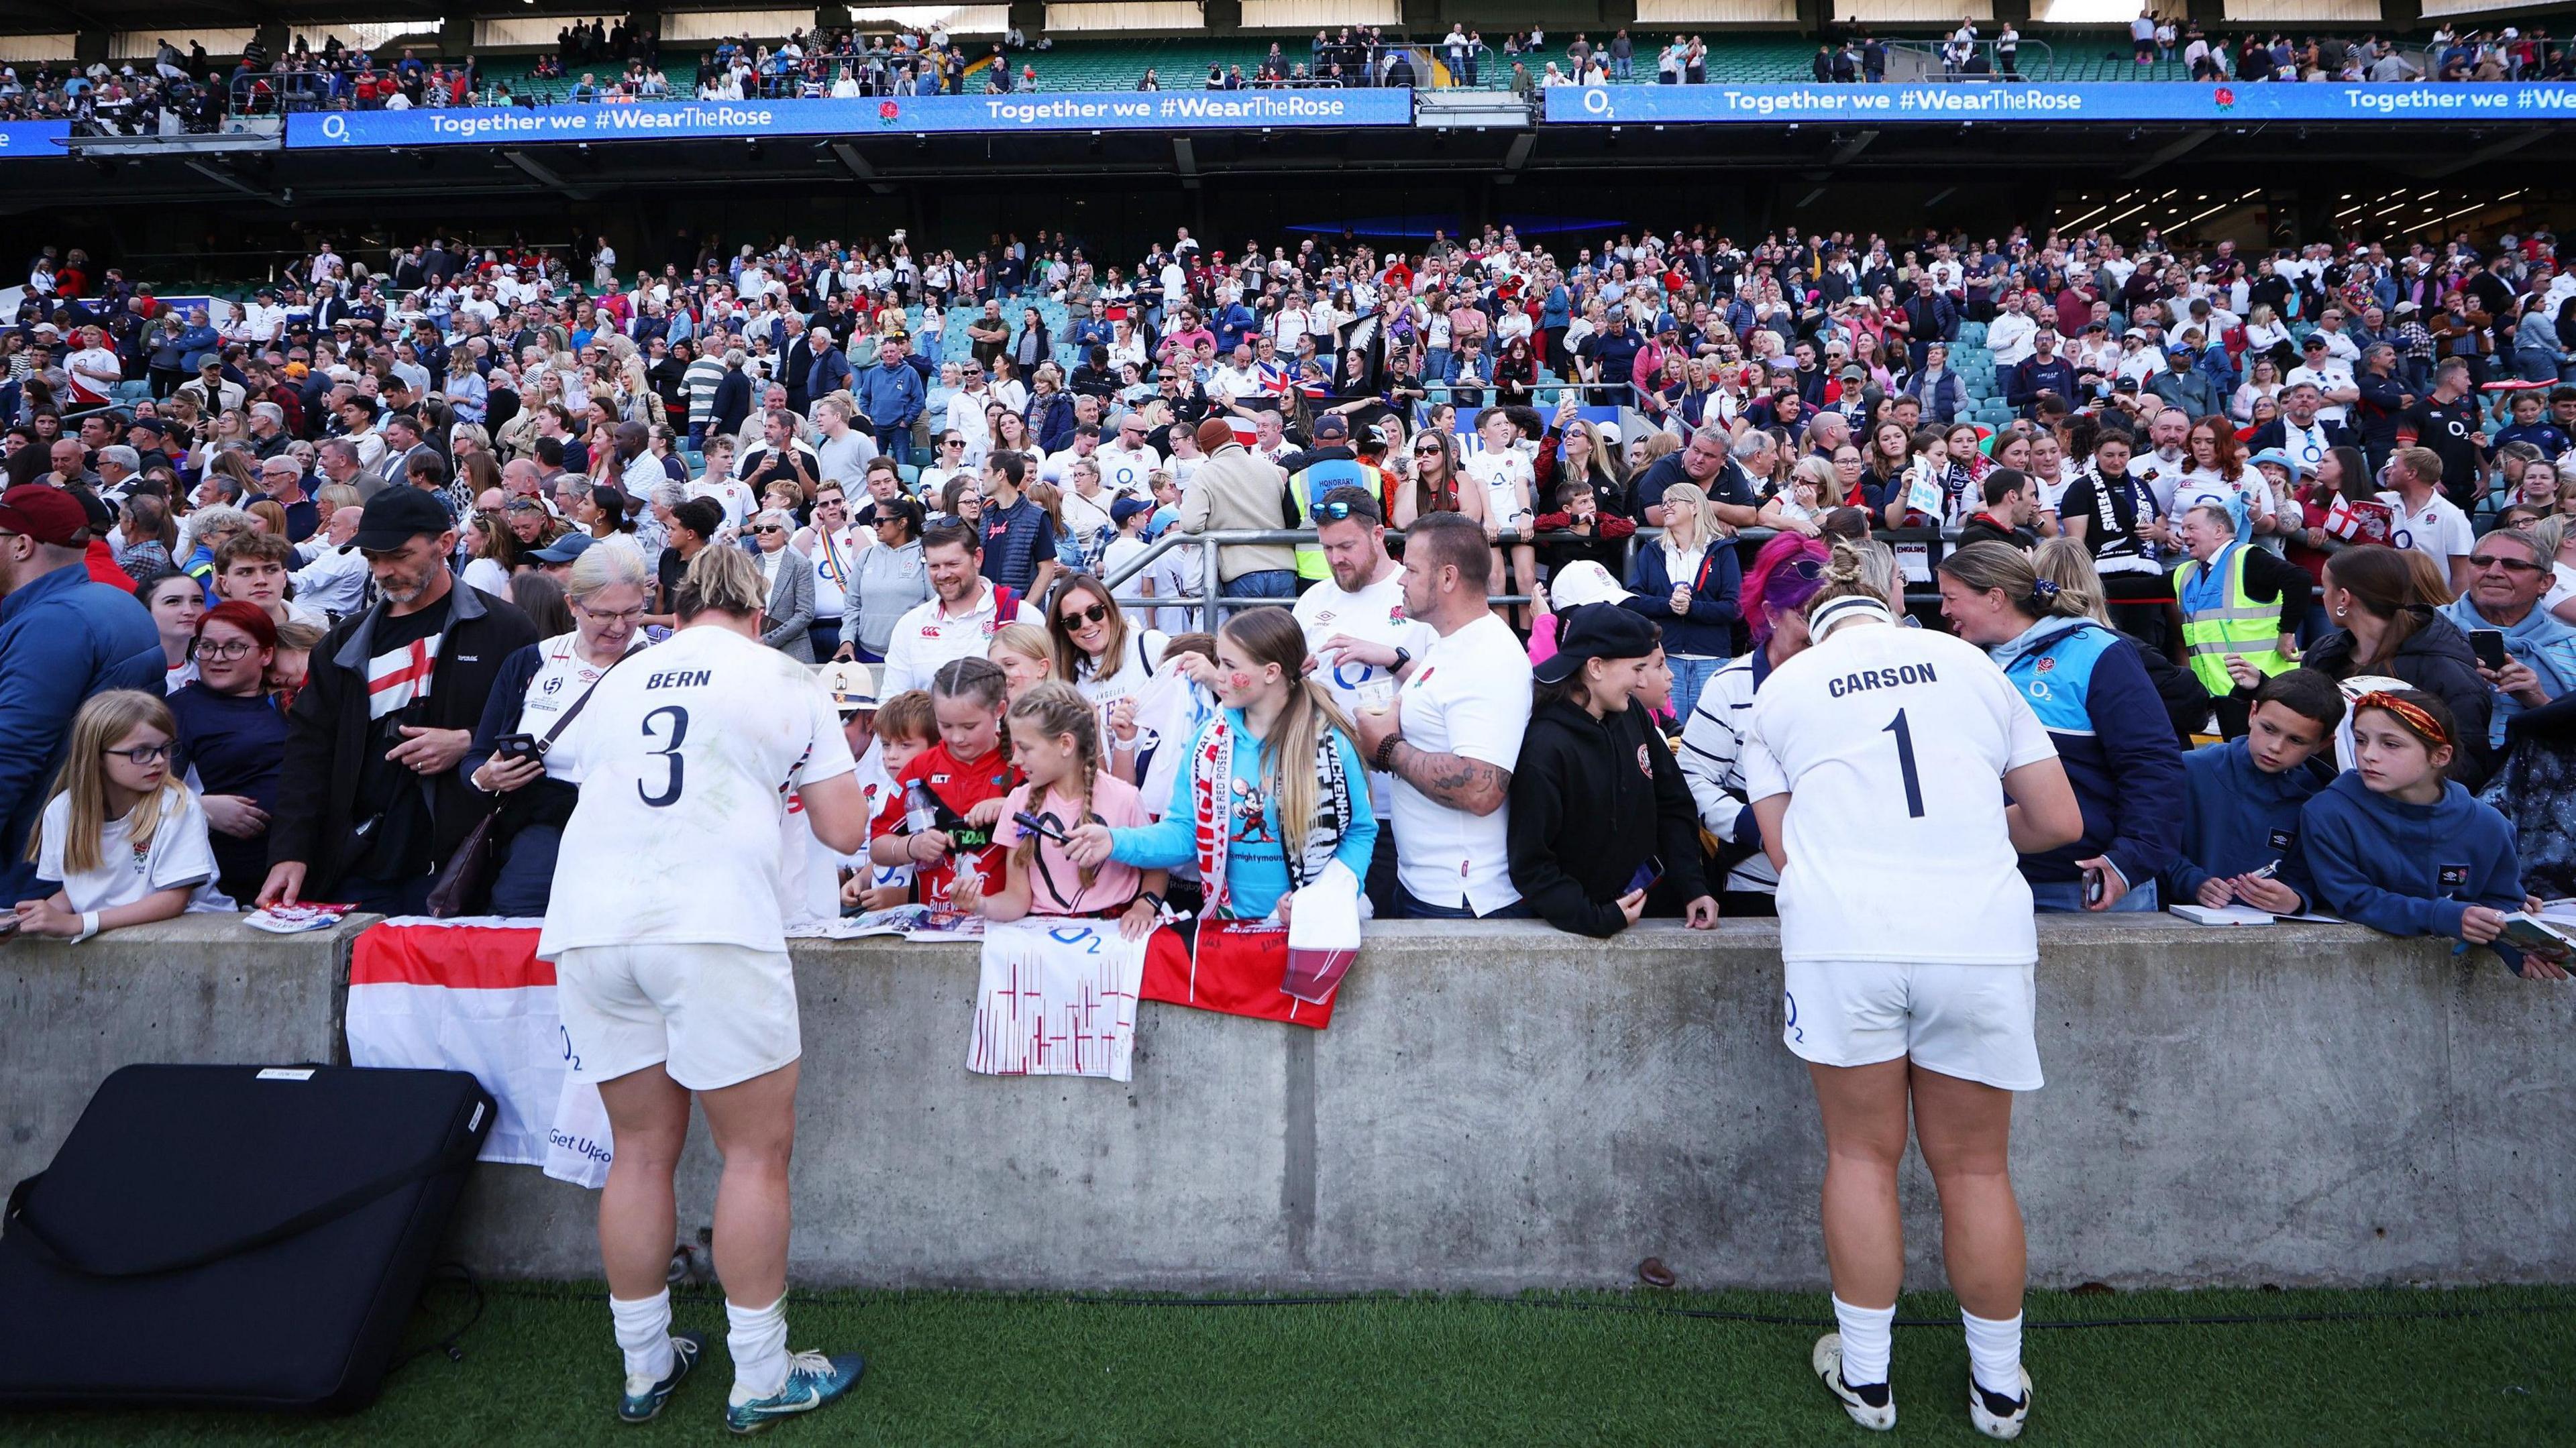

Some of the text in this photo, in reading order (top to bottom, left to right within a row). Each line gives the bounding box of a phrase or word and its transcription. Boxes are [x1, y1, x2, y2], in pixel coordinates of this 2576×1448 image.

[985, 96, 1344, 123] Together we #WearTheRose
[1584, 89, 2082, 119] O2 Together we #WearTheRose
[2345, 89, 2466, 112] Together
[2470, 93, 2508, 107] we
[322, 107, 772, 142] O2 Together we #WearTheRose
[2448, 421, 2471, 441] O2
[1116, 467, 1138, 488] O2
[1319, 478, 1354, 488] HONORARY
[1896, 545, 1927, 553] ENGLAND
[645, 670, 712, 690] BERN
[1828, 662, 1938, 698] CARSON
[2029, 680, 2053, 702] O2
[1095, 686, 1126, 702] ANGELES
[637, 705, 689, 807] 3
[1881, 707, 1925, 818] 1
[1217, 804, 1226, 820] THE
[549, 1128, 576, 1150] Get
